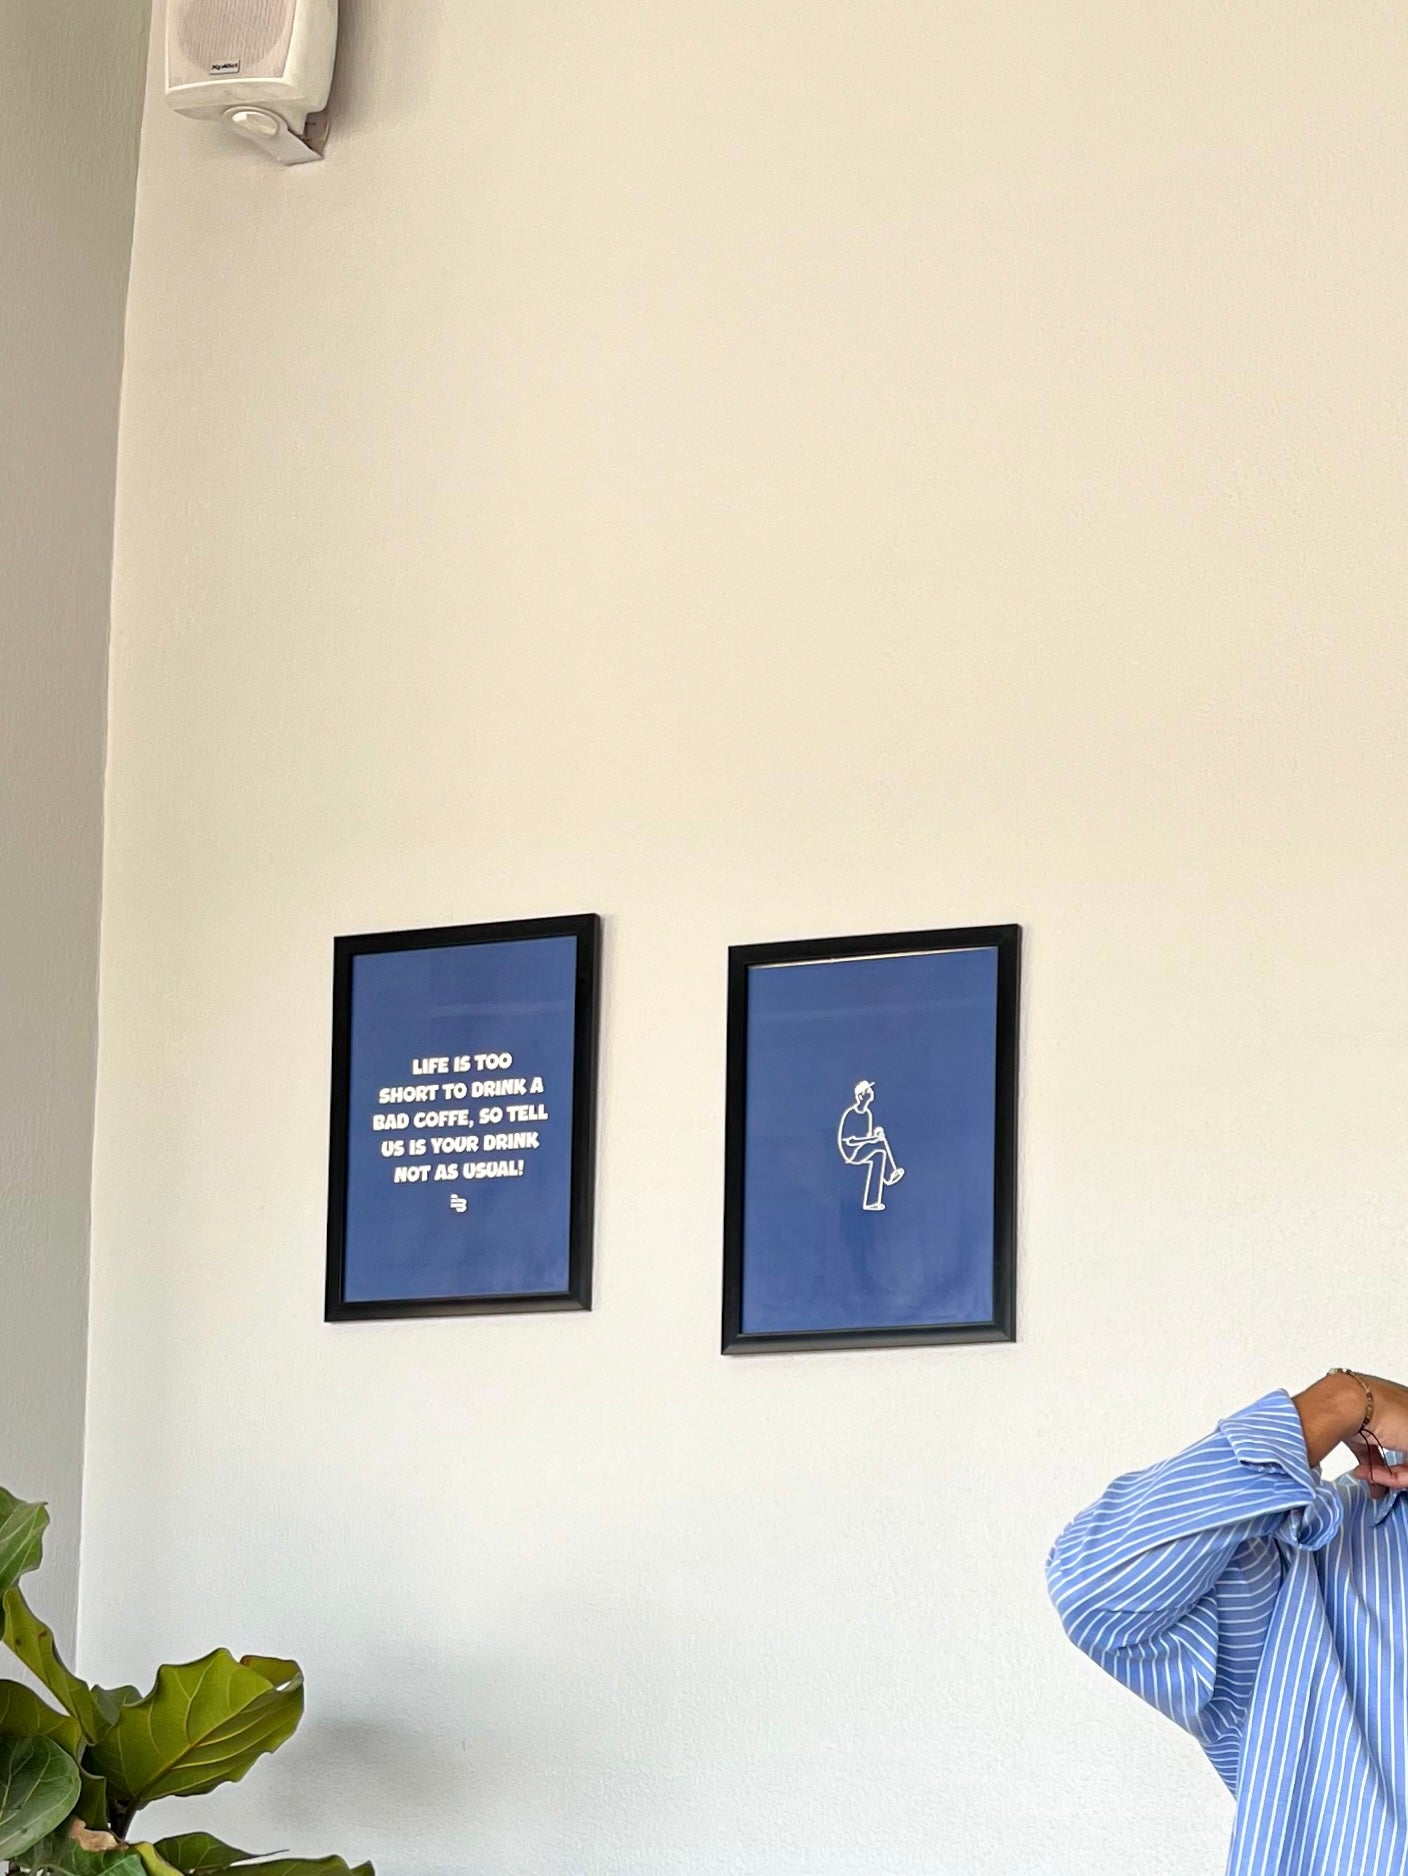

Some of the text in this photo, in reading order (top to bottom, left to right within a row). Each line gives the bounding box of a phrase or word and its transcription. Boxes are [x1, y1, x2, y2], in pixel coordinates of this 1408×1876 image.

[412, 1052, 512, 1075] LIFE IS TOO
[378, 1077, 544, 1104] SHORT TO DRINK A
[372, 1104, 548, 1131] BAD COFFE, SO TELL
[381, 1131, 540, 1157] US IS YOUR DRINK
[394, 1159, 524, 1183] NOT AS USUAL!
